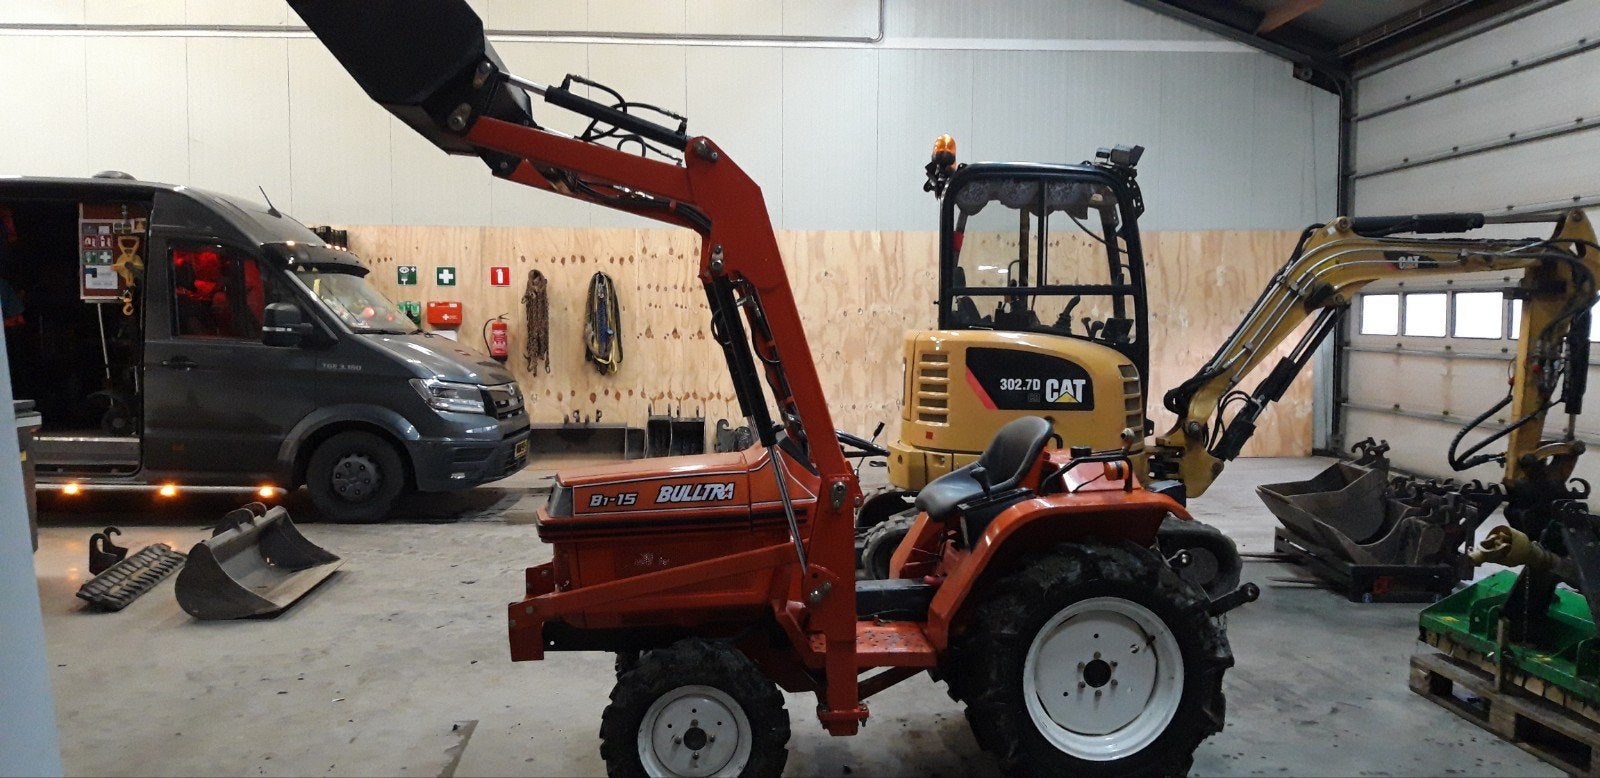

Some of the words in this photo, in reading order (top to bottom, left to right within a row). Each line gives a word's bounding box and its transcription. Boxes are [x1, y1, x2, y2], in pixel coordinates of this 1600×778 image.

[1399, 256, 1420, 269] CAT
[999, 378, 1041, 391] 302.7D
[1045, 378, 1086, 403] CAT
[589, 493, 638, 507] B1-15
[655, 482, 735, 503] BULLTRA
